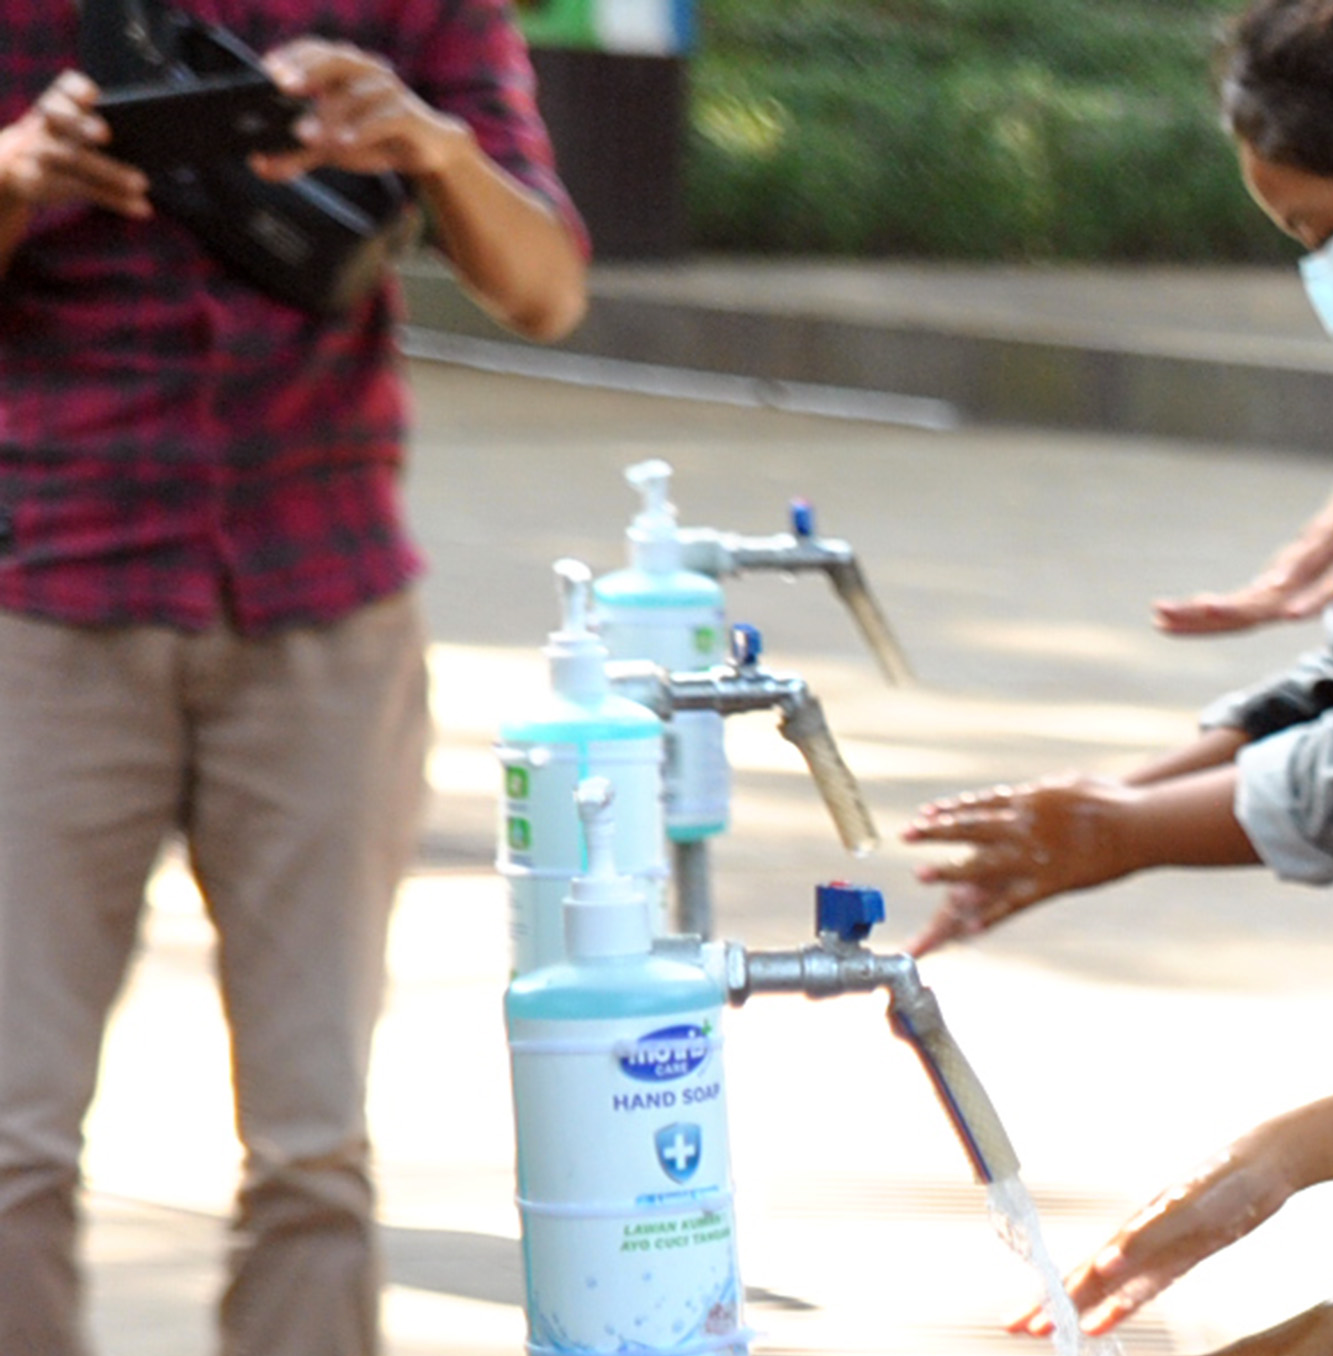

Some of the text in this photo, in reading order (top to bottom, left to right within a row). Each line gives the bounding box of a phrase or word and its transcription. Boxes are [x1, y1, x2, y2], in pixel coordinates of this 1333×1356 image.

[612, 1082, 721, 1111] HAND SOAP
[620, 1239, 651, 1252] AYO
[654, 1235, 689, 1250] CUCI
